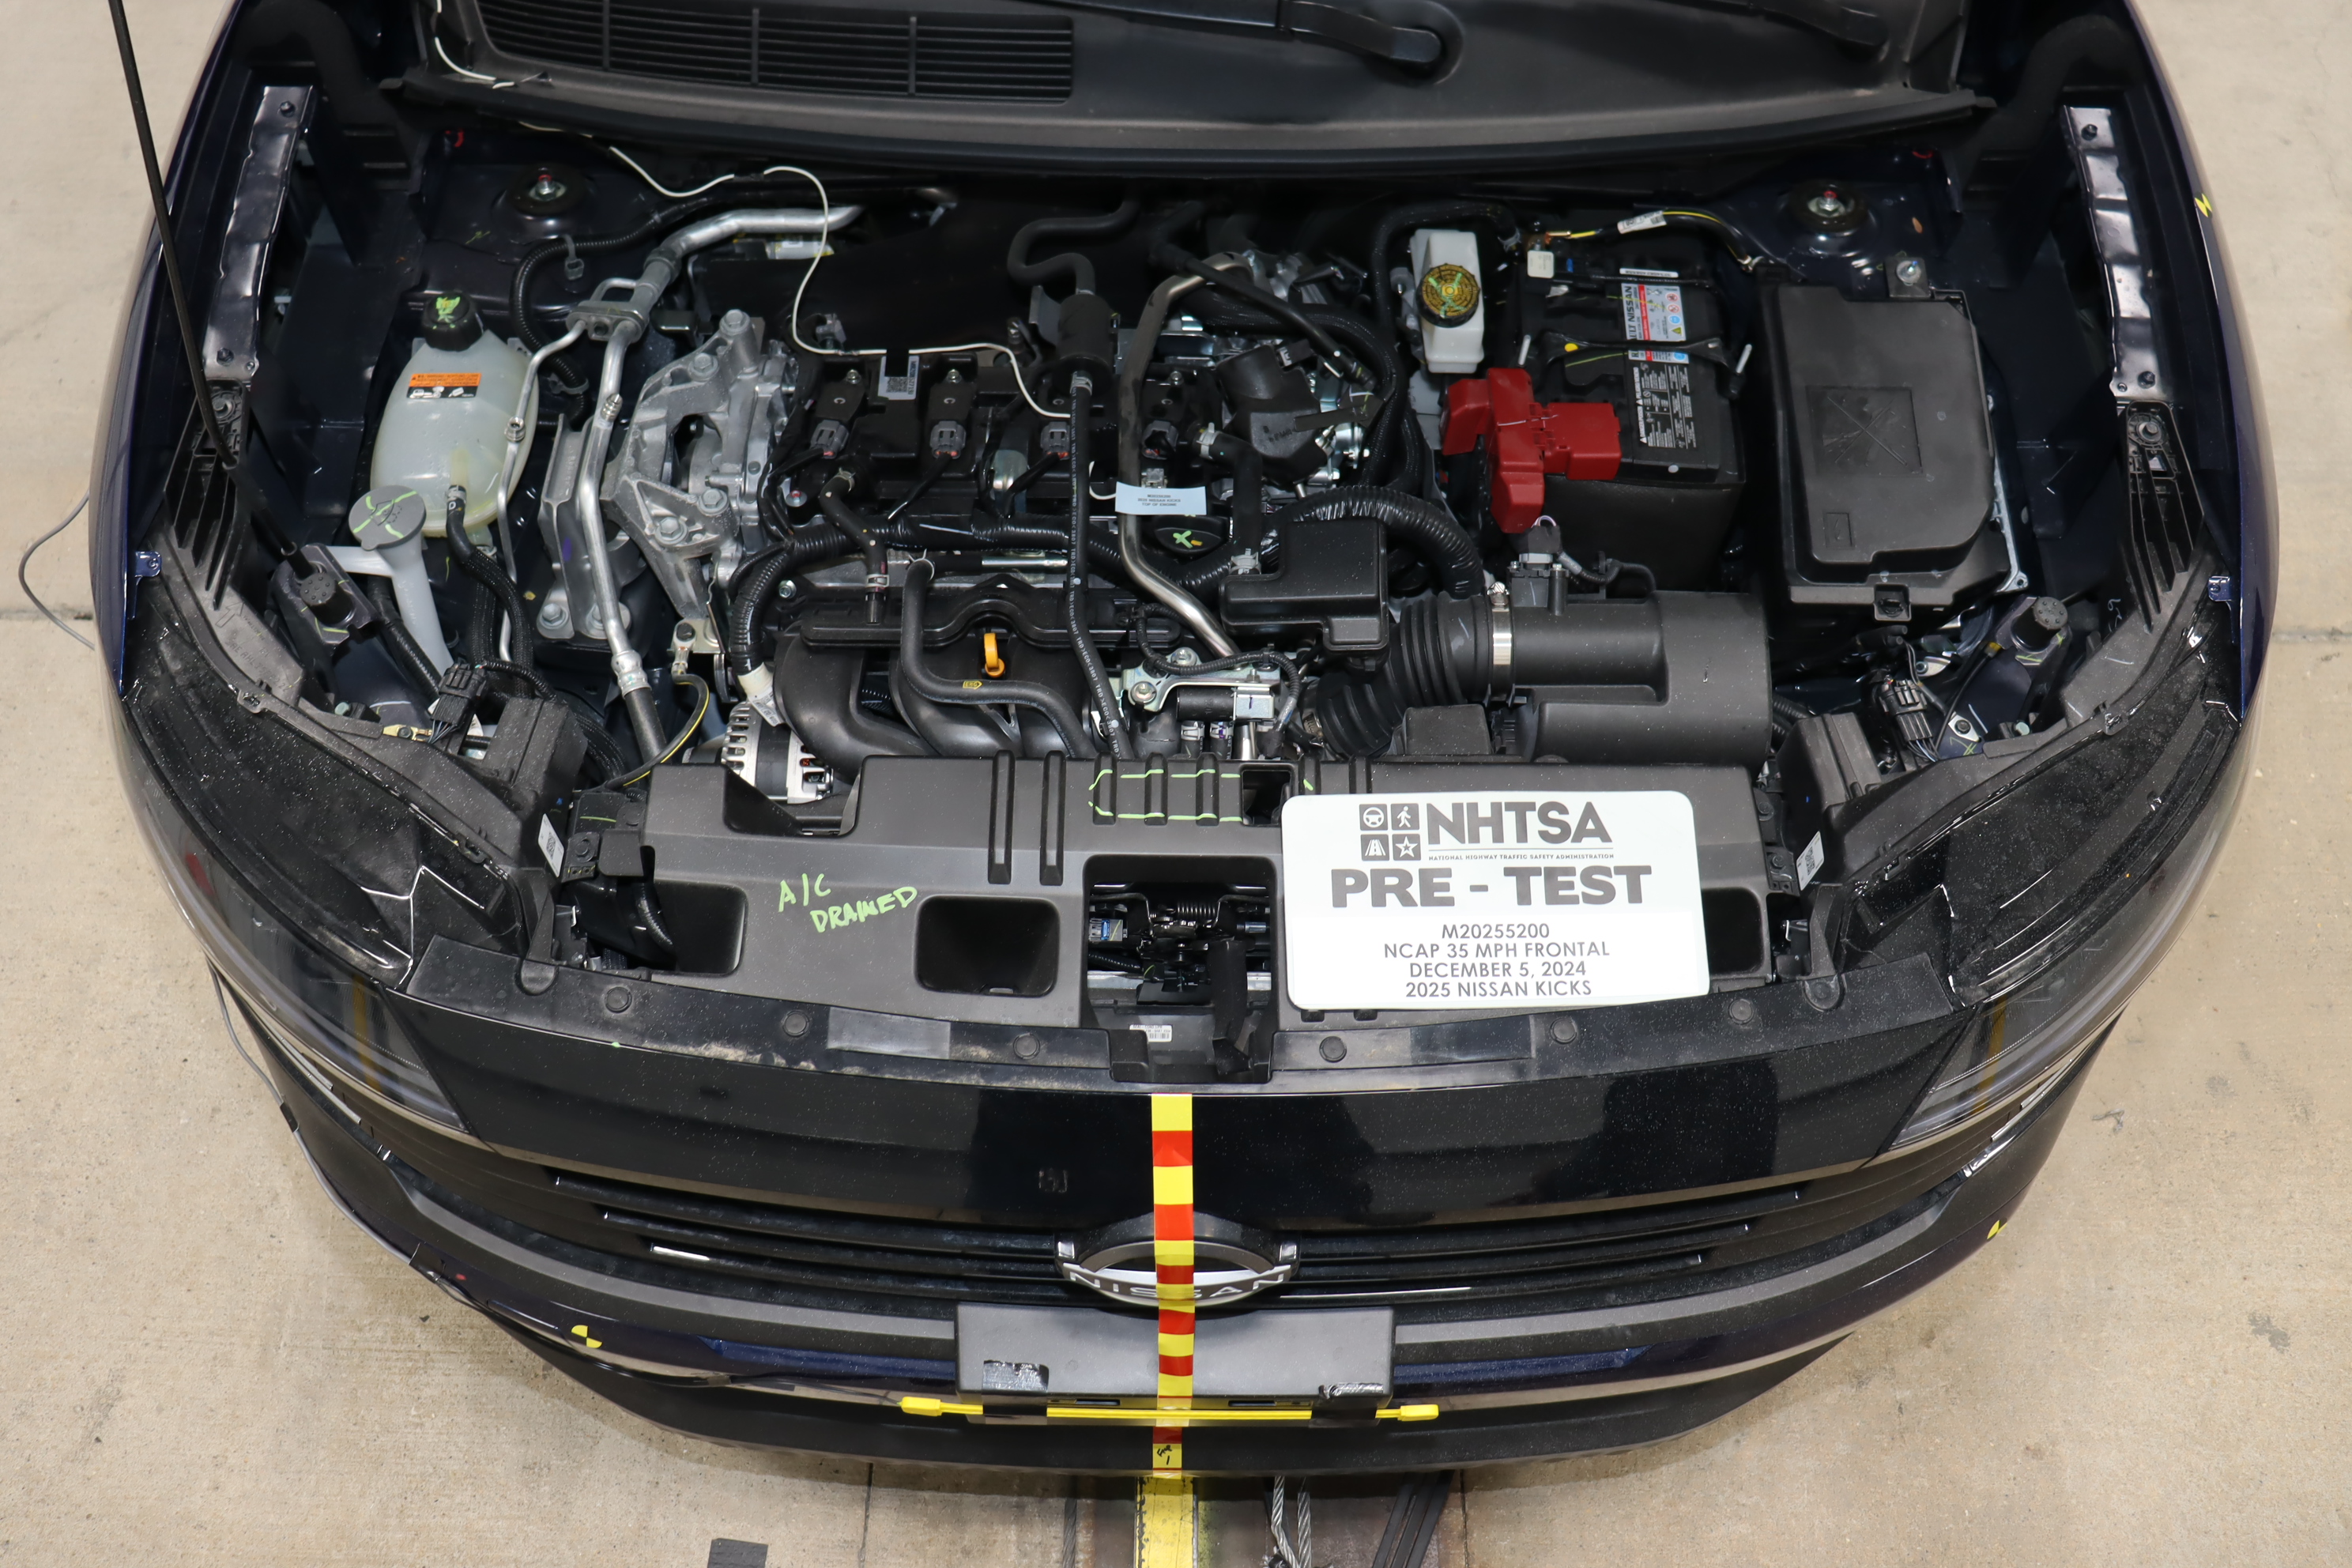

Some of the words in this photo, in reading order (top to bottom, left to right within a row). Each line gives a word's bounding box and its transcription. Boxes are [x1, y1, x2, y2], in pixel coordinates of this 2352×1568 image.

[1624, 286, 1635, 322] NISSAN
[1427, 801, 1612, 845] NHTSA
[778, 873, 831, 912] A/C
[1331, 868, 1455, 908] PRE
[1503, 865, 1652, 906] TEST
[809, 886, 918, 933] DRAINED
[1442, 923, 1550, 939] M20255200
[1385, 943, 1439, 958] NCAP
[1447, 943, 1468, 958] 35
[1476, 943, 1517, 958] MPH
[1525, 941, 1610, 957] FRONTAL
[1410, 963, 1512, 978] DECEMBER
[1519, 963, 1535, 979] 5,
[1542, 961, 1586, 976] 2024
[1406, 982, 1450, 997] 2025
[1458, 982, 1528, 997] NISSAN
[1536, 981, 1592, 996] KICKS
[1069, 1271, 1284, 1298] NISAN
